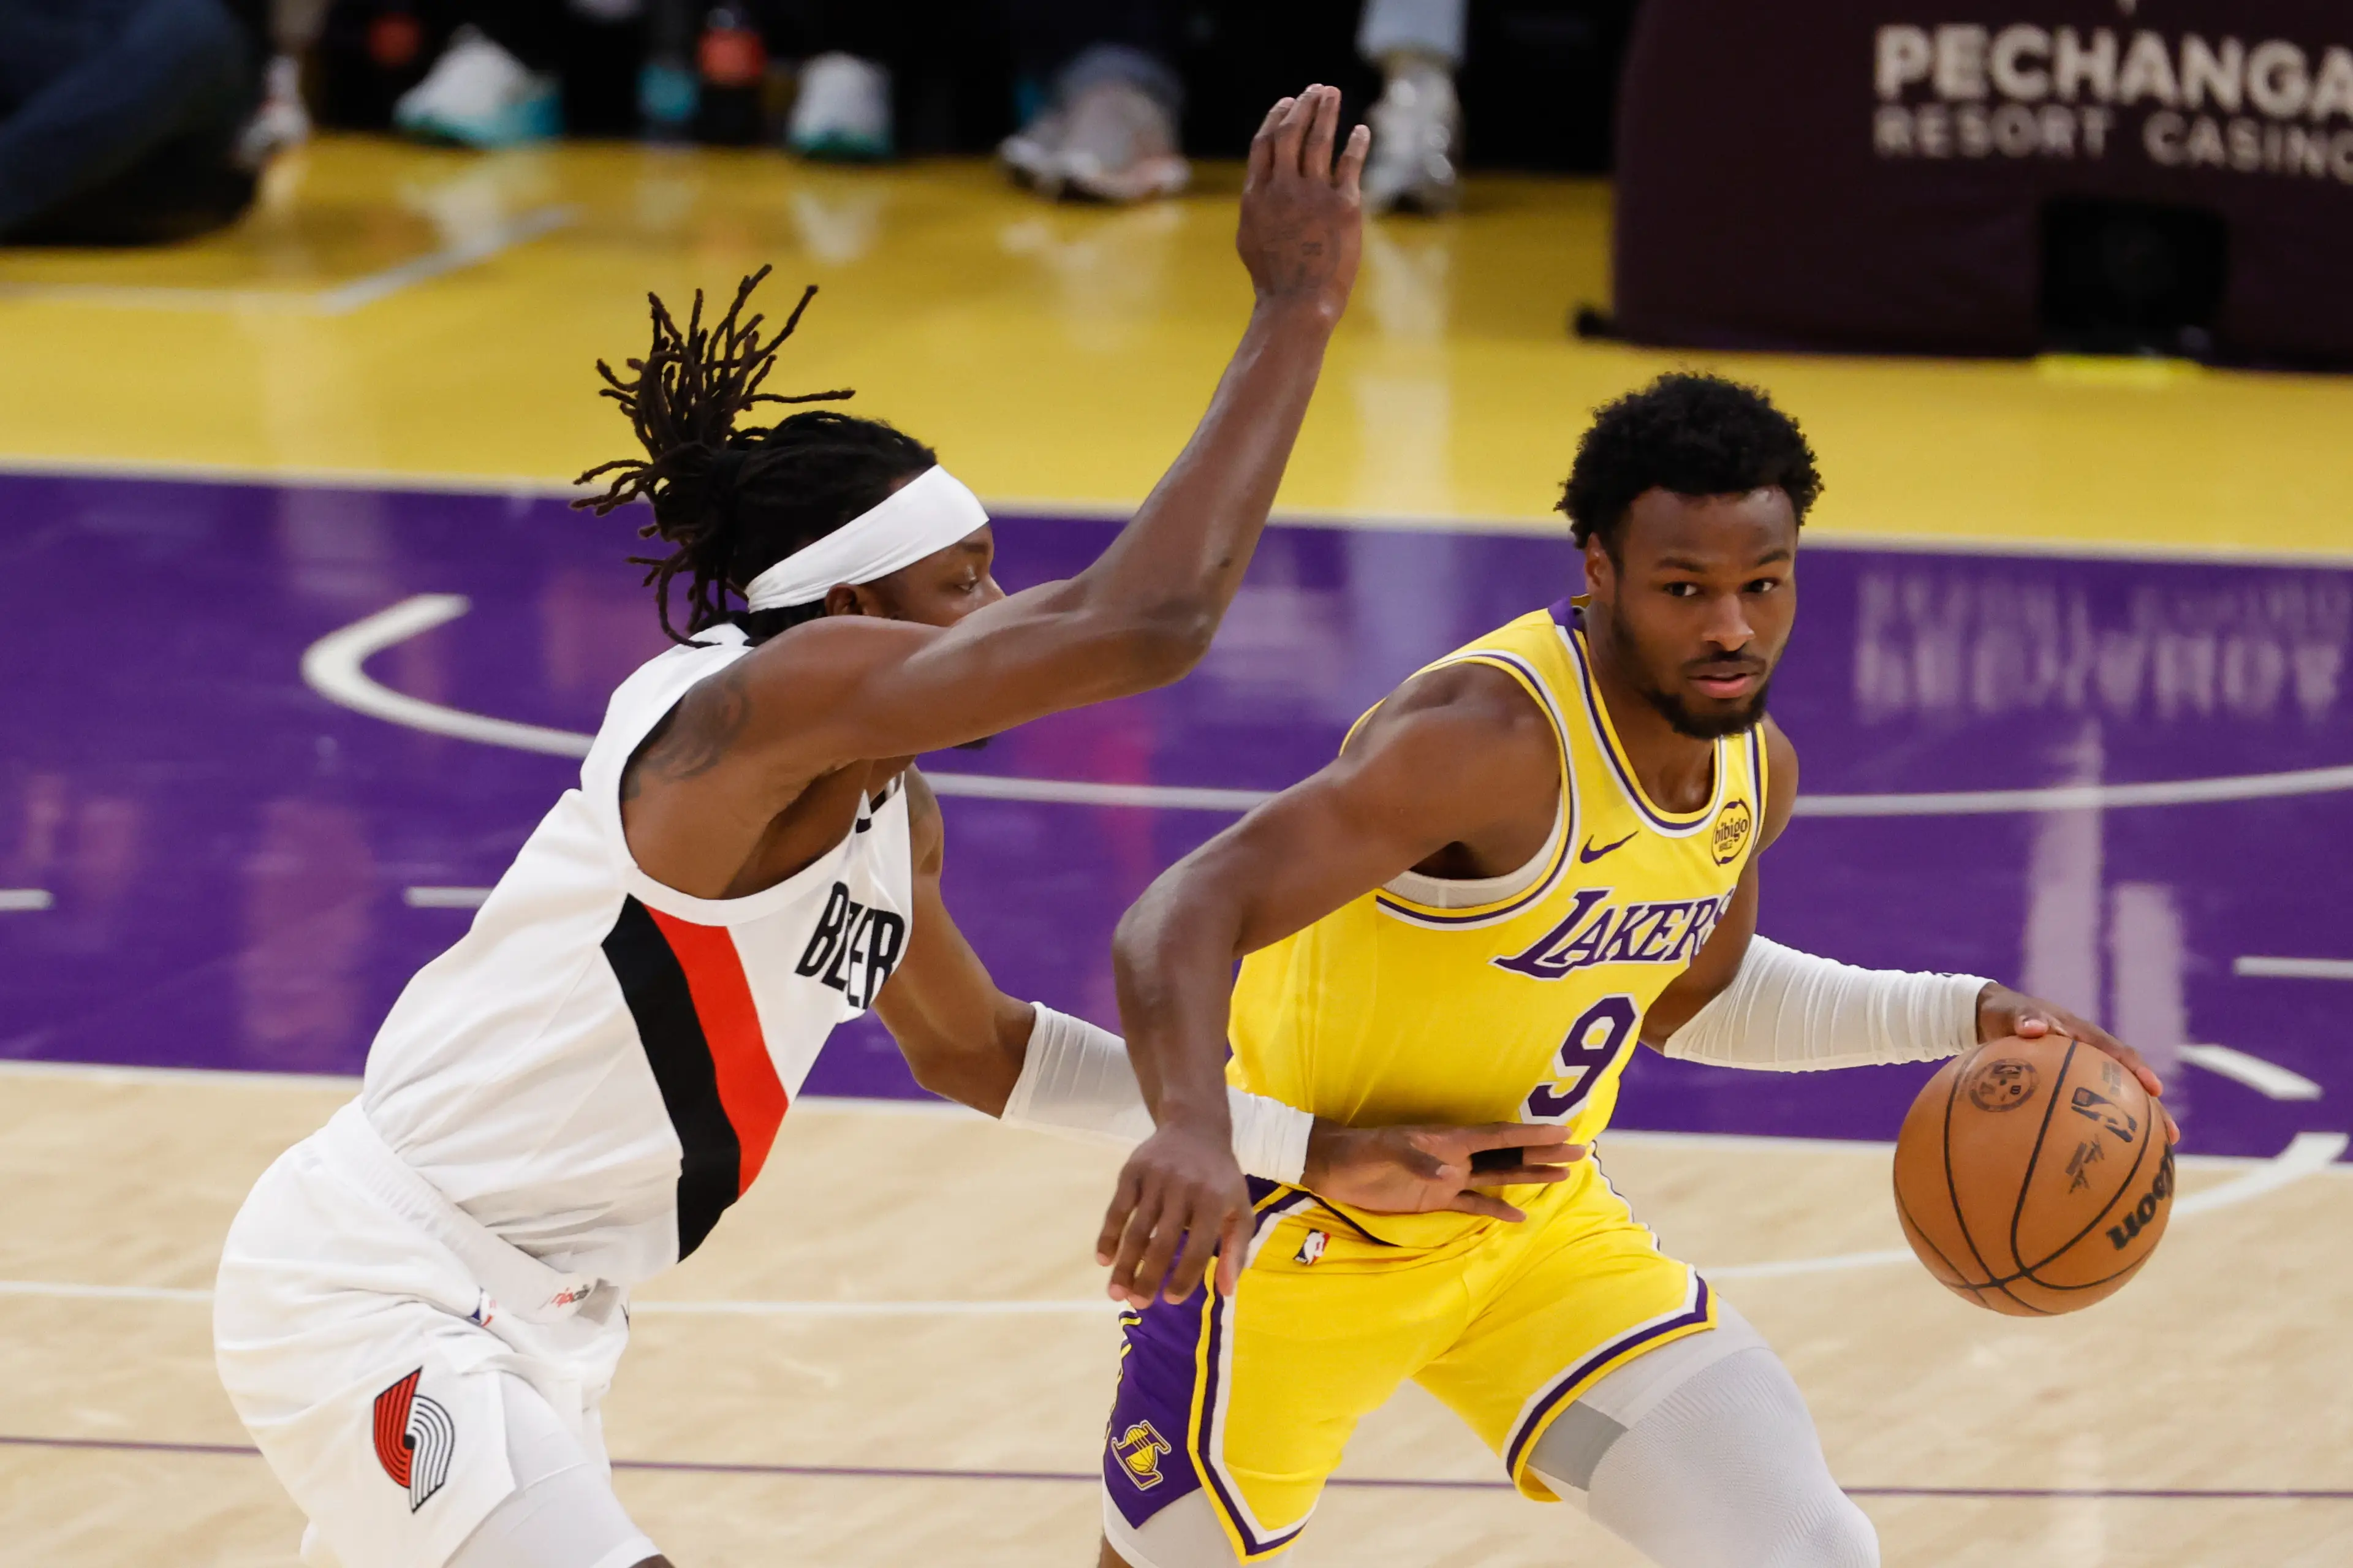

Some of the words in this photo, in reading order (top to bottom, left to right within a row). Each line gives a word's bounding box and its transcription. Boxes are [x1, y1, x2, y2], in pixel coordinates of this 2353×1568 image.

[1874, 25, 2353, 121] PECHANGA
[1873, 103, 2111, 158] RESORT
[1715, 817, 1748, 844] bibigo
[1519, 992, 1642, 1126] 9
